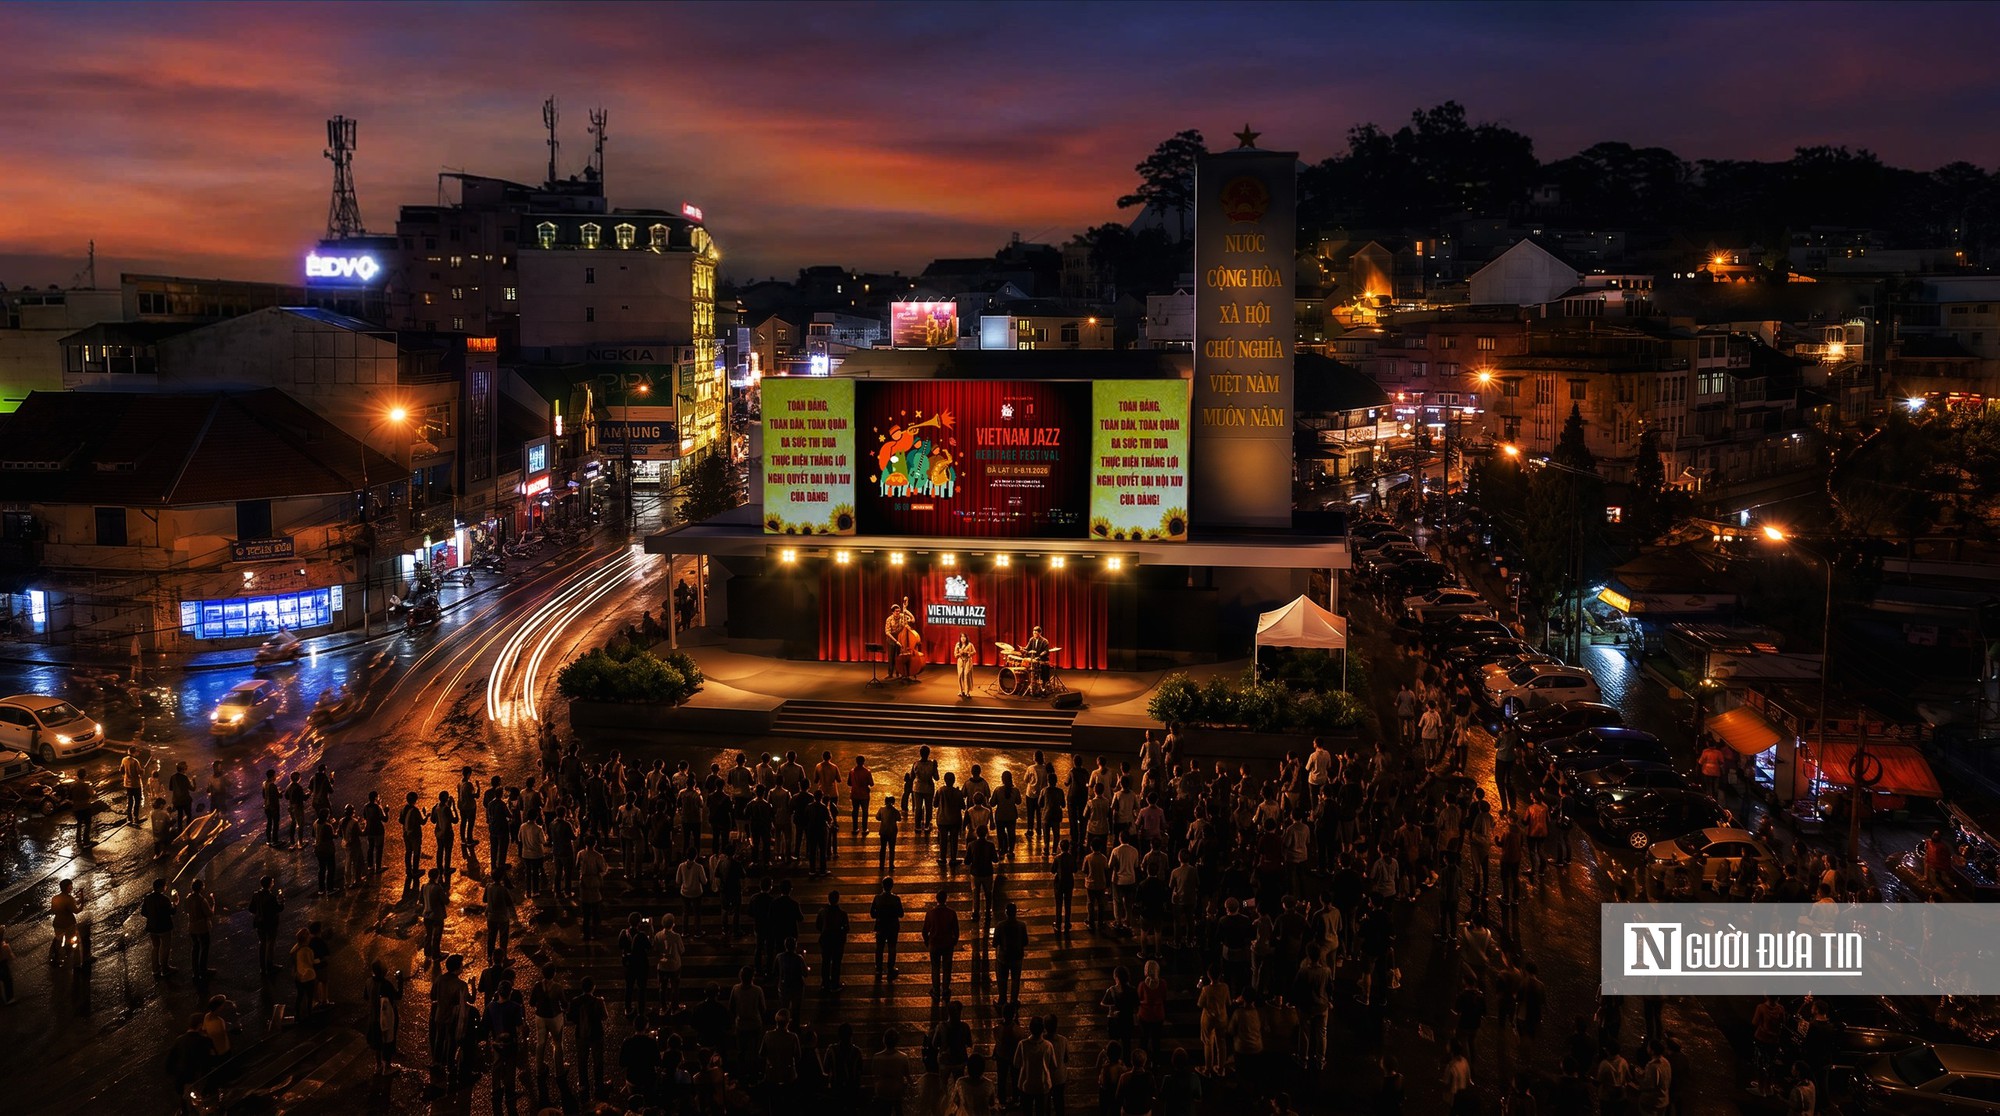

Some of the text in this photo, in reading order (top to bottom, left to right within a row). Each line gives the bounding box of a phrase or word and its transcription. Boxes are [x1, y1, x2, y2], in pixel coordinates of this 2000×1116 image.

[1207, 264, 1282, 291] CỘNG HÒA
[1245, 301, 1271, 328] HỘI
[1209, 370, 1243, 397] VIỆT
[1203, 404, 1285, 427] MUÔN NĂM
[976, 427, 1061, 446] VIETNAM JAZZ
[976, 449, 1060, 461] HERITAGE FESTIVAL
[838, 474, 851, 485] XIV
[1170, 476, 1183, 487] XIV
[928, 604, 986, 617] VIETNAM JAZZ
[928, 616, 986, 626] HERITAGE FESTIVAL
